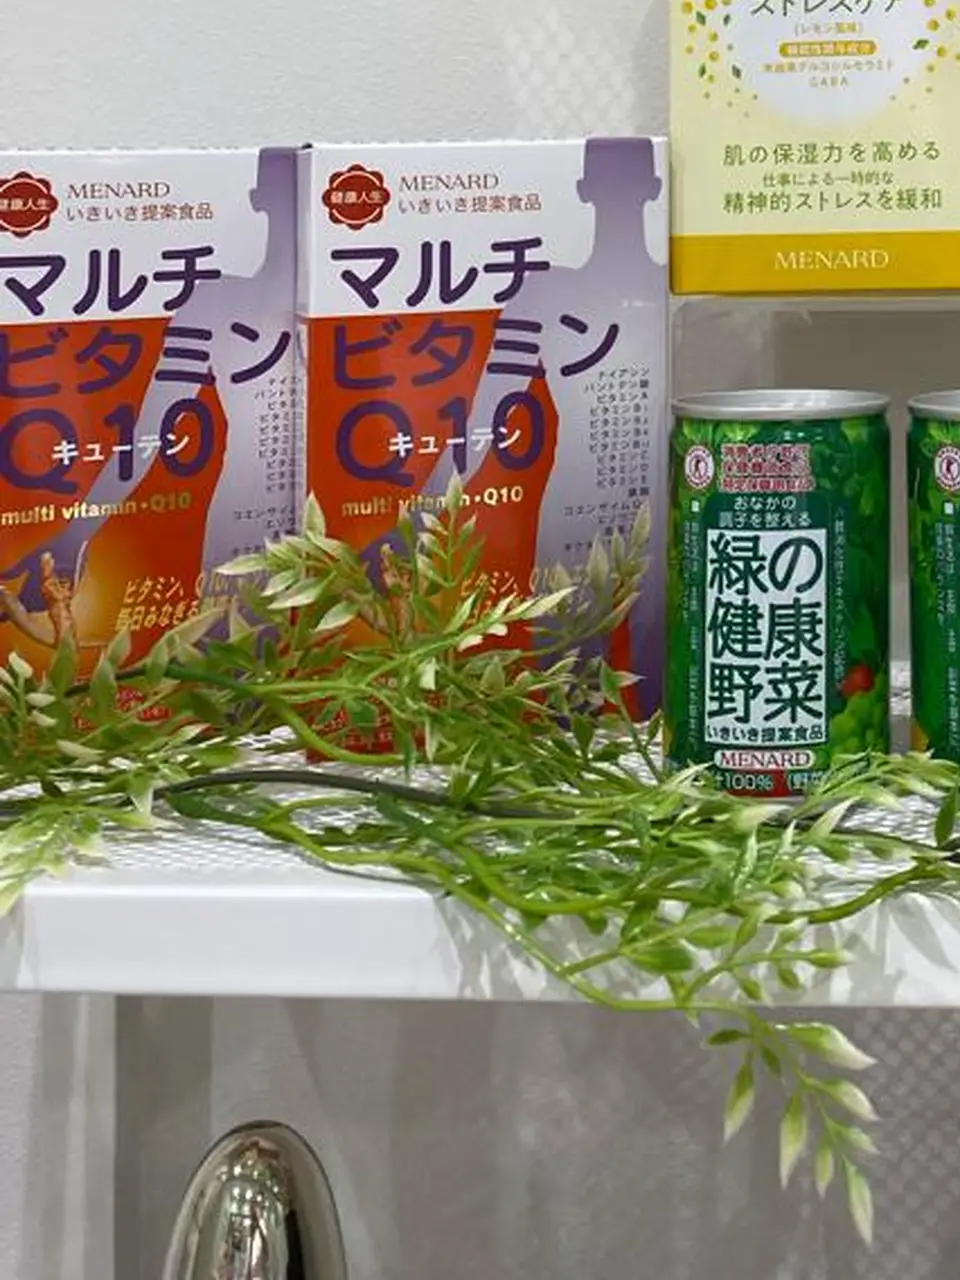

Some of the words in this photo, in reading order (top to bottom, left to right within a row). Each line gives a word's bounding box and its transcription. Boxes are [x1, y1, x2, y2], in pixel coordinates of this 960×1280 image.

[723, 141, 941, 167] 肌の保湿力を高める
[67, 183, 171, 200] MENARD
[399, 175, 499, 192] MENARD
[762, 171, 894, 187] 仕事による一時的な
[330, 190, 383, 205] 健康人生
[398, 194, 542, 213] いきいき提案食品
[723, 189, 942, 215] 精神的ストレスを緩和
[67, 202, 214, 221] いきいき提案食品
[331, 237, 550, 308] マルチ
[774, 250, 889, 270] MENARD
[0, 246, 221, 316] マルチ
[0, 322, 291, 395] ビタミン
[334, 314, 620, 390] ビタミン
[0, 397, 214, 494] Q10
[52, 431, 190, 465] キューテン
[335, 390, 544, 487] Q10
[389, 426, 522, 458] キューテン
[2, 504, 56, 526] multi
[734, 496, 797, 510] おなかの
[709, 531, 824, 595] 緑の
[708, 597, 824, 660] 健康
[708, 661, 823, 723] 野菜
[707, 725, 823, 742] いきいき提案食品
[720, 752, 810, 767] MENARD
